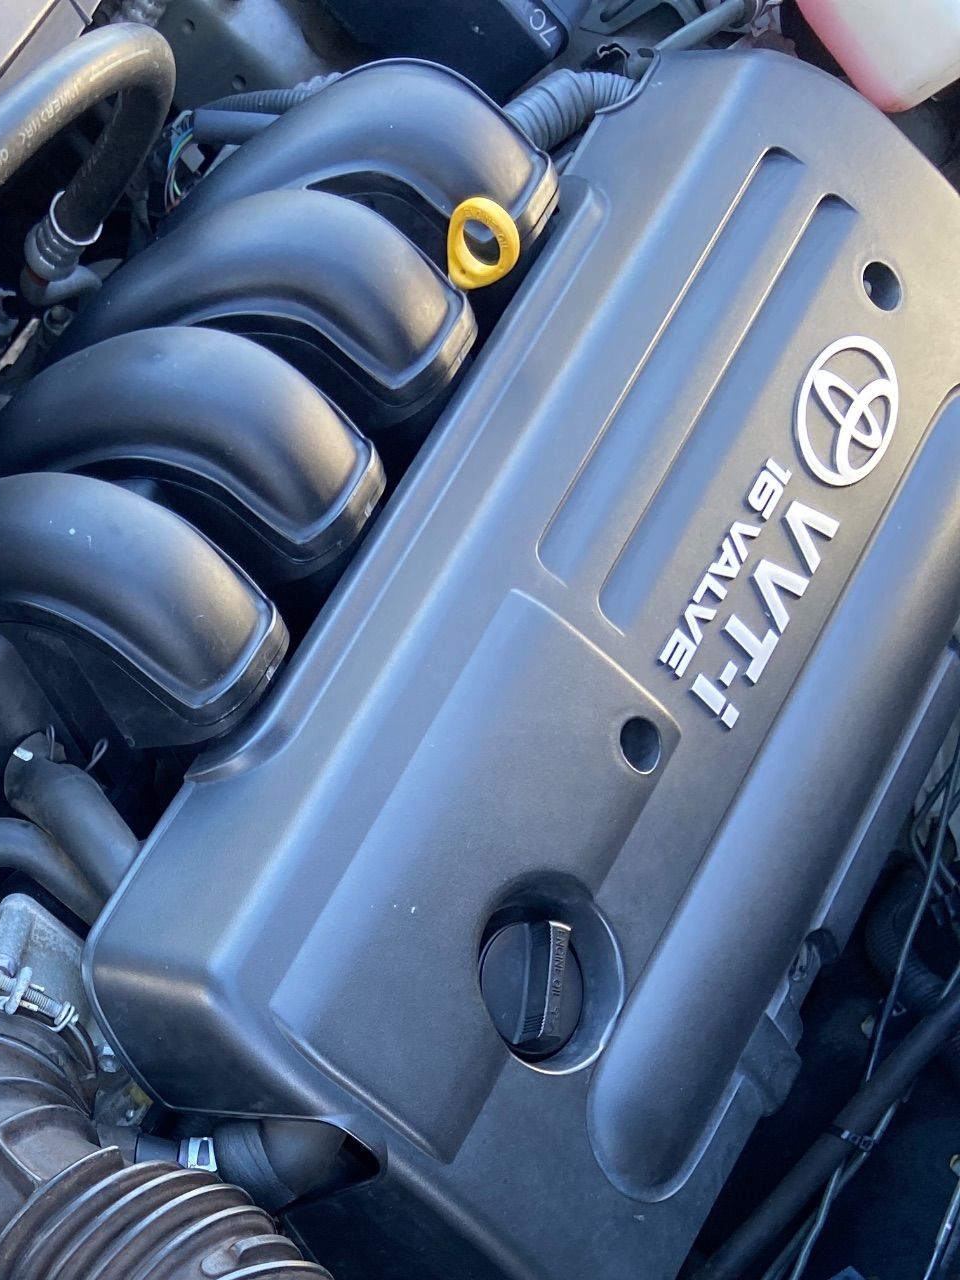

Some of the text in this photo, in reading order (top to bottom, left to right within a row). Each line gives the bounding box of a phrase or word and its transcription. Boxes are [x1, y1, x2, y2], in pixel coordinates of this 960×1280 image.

[654, 455, 794, 679] 16 VALVE
[682, 496, 841, 730] VVT-i
